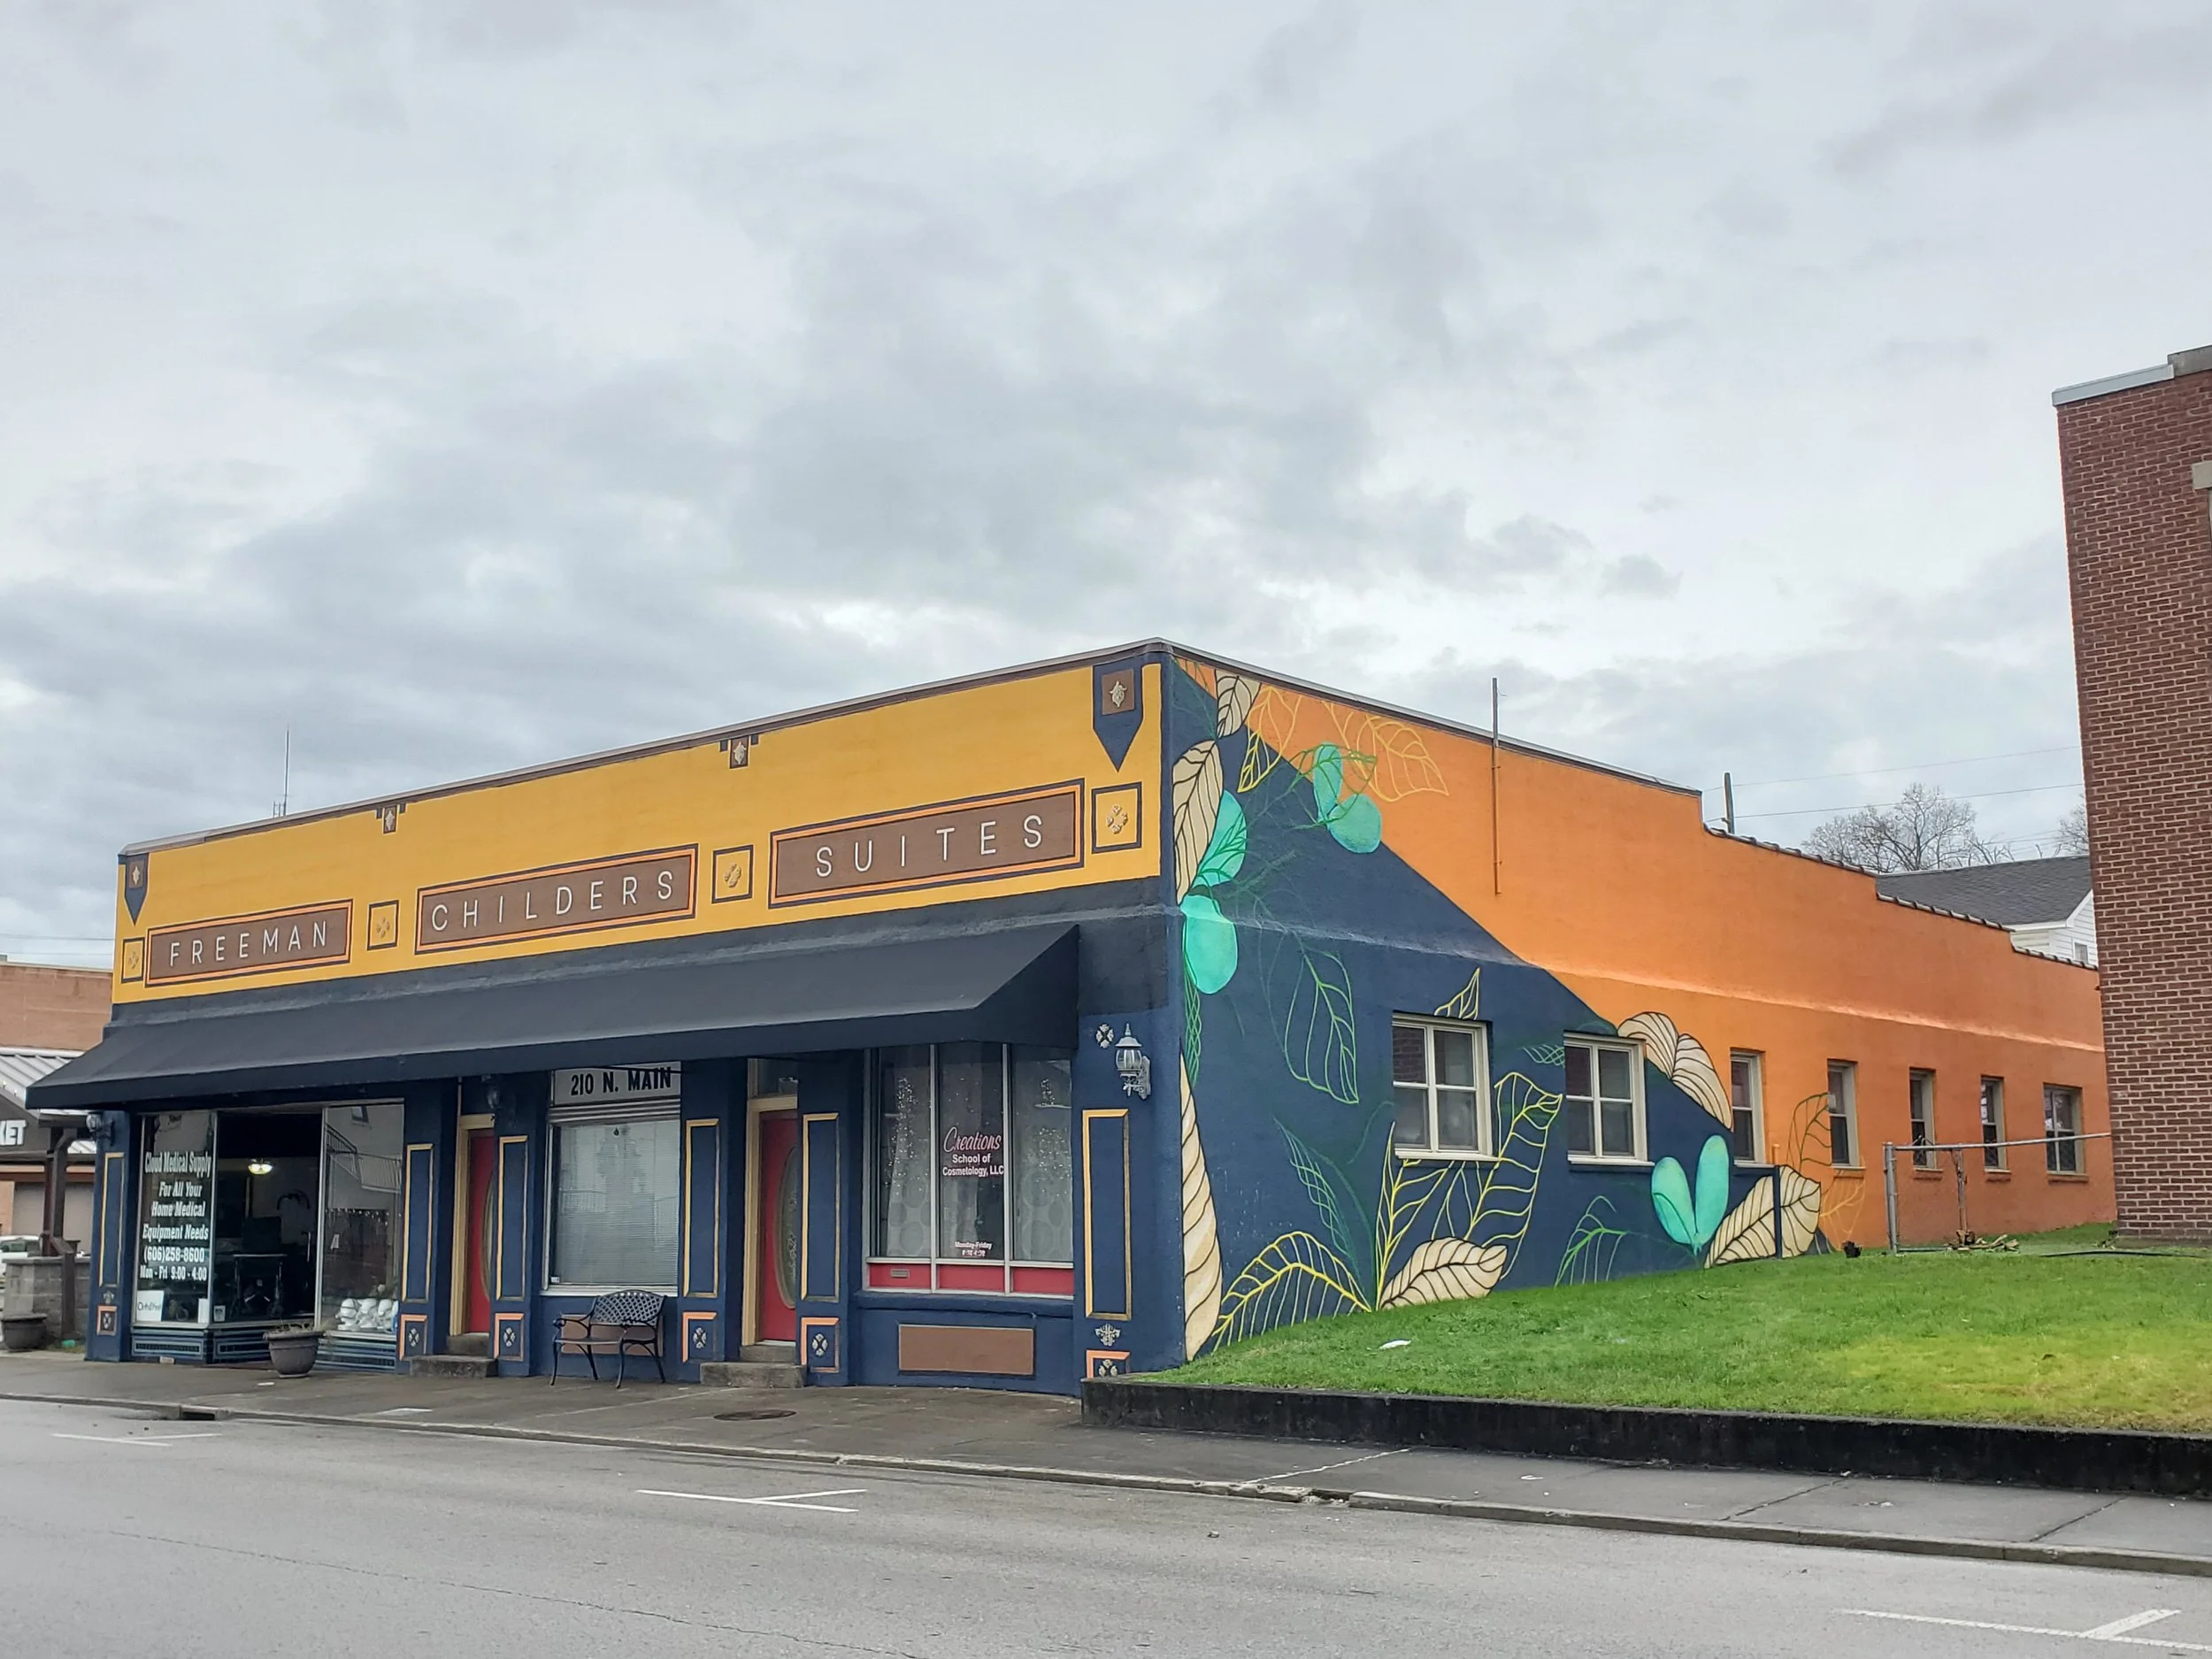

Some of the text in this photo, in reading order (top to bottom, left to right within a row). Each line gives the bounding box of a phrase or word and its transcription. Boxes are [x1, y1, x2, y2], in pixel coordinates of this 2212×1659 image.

[169, 815, 1042, 967] FREEMAN CHILDERS SUITES
[571, 1066, 672, 1096] 210 N. MAIN
[943, 1126, 1002, 1152] Creations
[144, 1151, 211, 1179] Cloud Medical Supply
[952, 1153, 991, 1164] School of
[942, 1165, 1004, 1178] Cosmetology, LLC
[159, 1181, 203, 1197] For All Your
[151, 1201, 206, 1217] Home Medical
[142, 1223, 209, 1242] Equipment Needs
[143, 1245, 205, 1263] (606)258-8600
[140, 1264, 153, 1279] Mon
[159, 1265, 168, 1279] Fri
[171, 1265, 186, 1280] 9:00
[192, 1266, 207, 1281] 4:00
